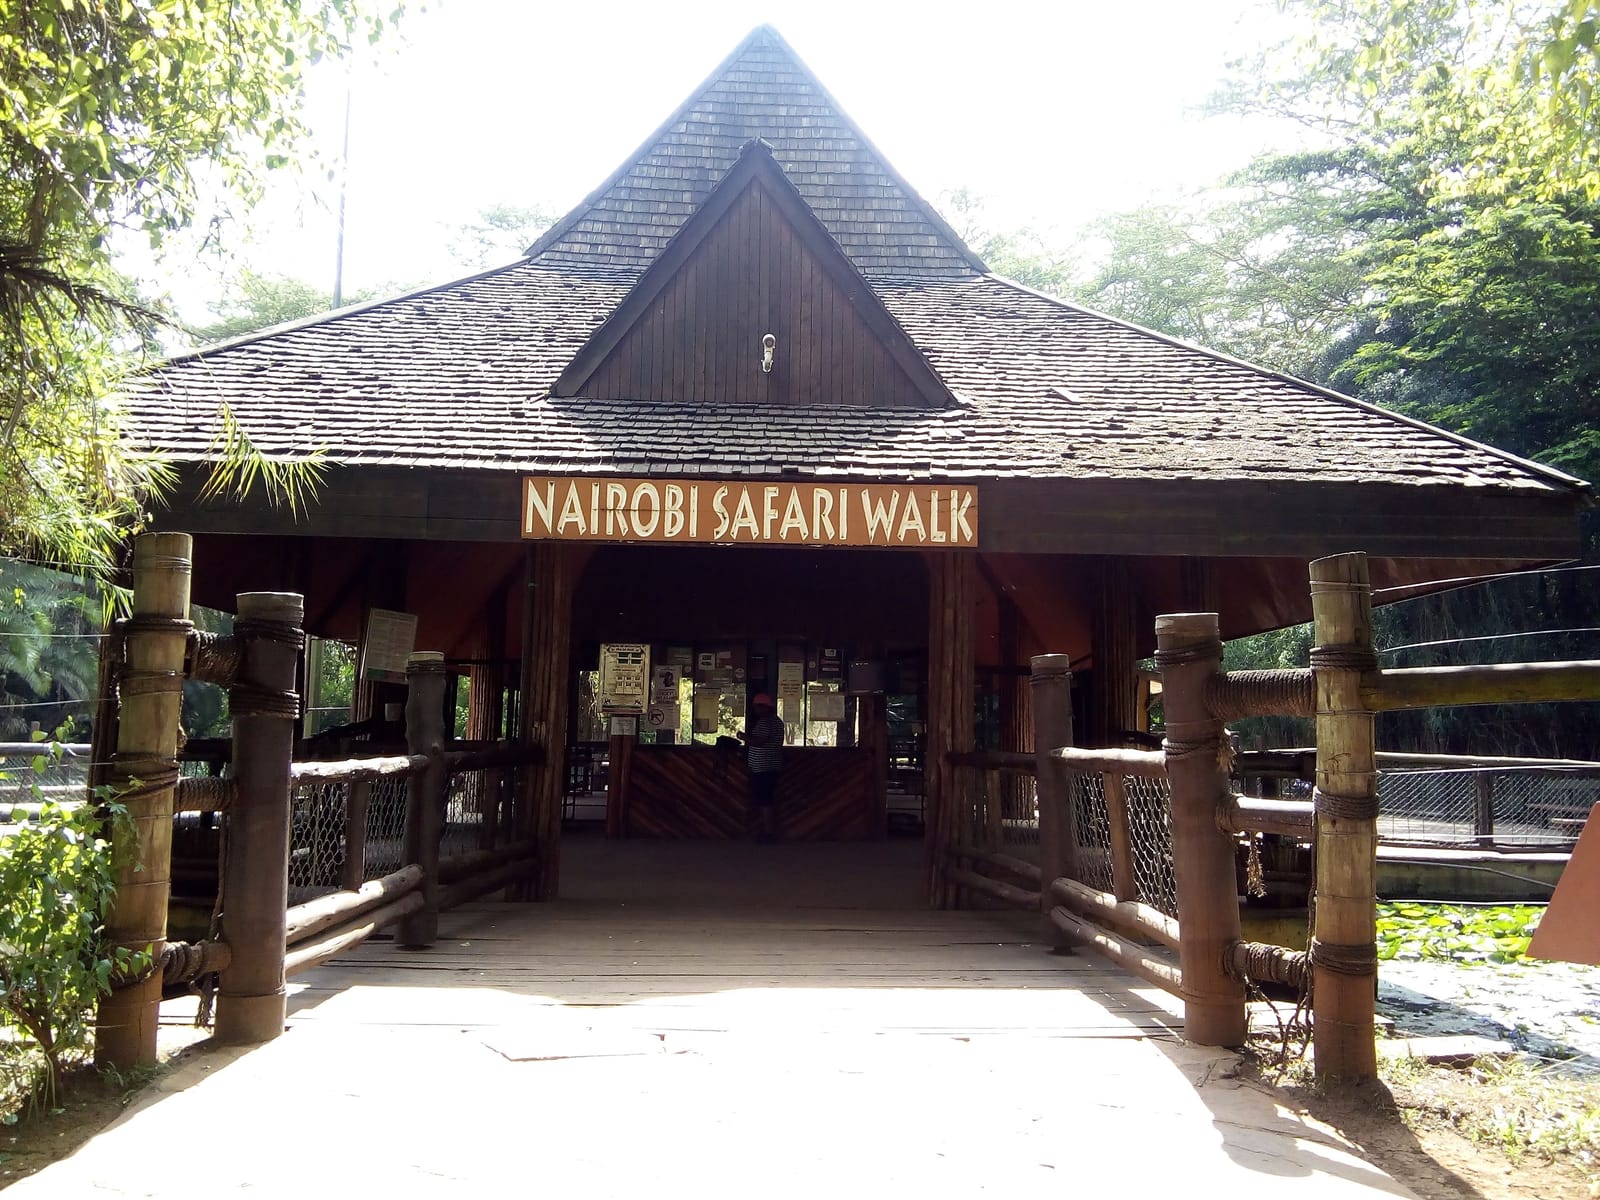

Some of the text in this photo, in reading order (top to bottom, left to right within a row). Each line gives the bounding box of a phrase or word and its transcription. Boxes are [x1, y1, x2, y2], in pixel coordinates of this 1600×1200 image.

[526, 479, 973, 543] NAIROBI SAFARI WALK
